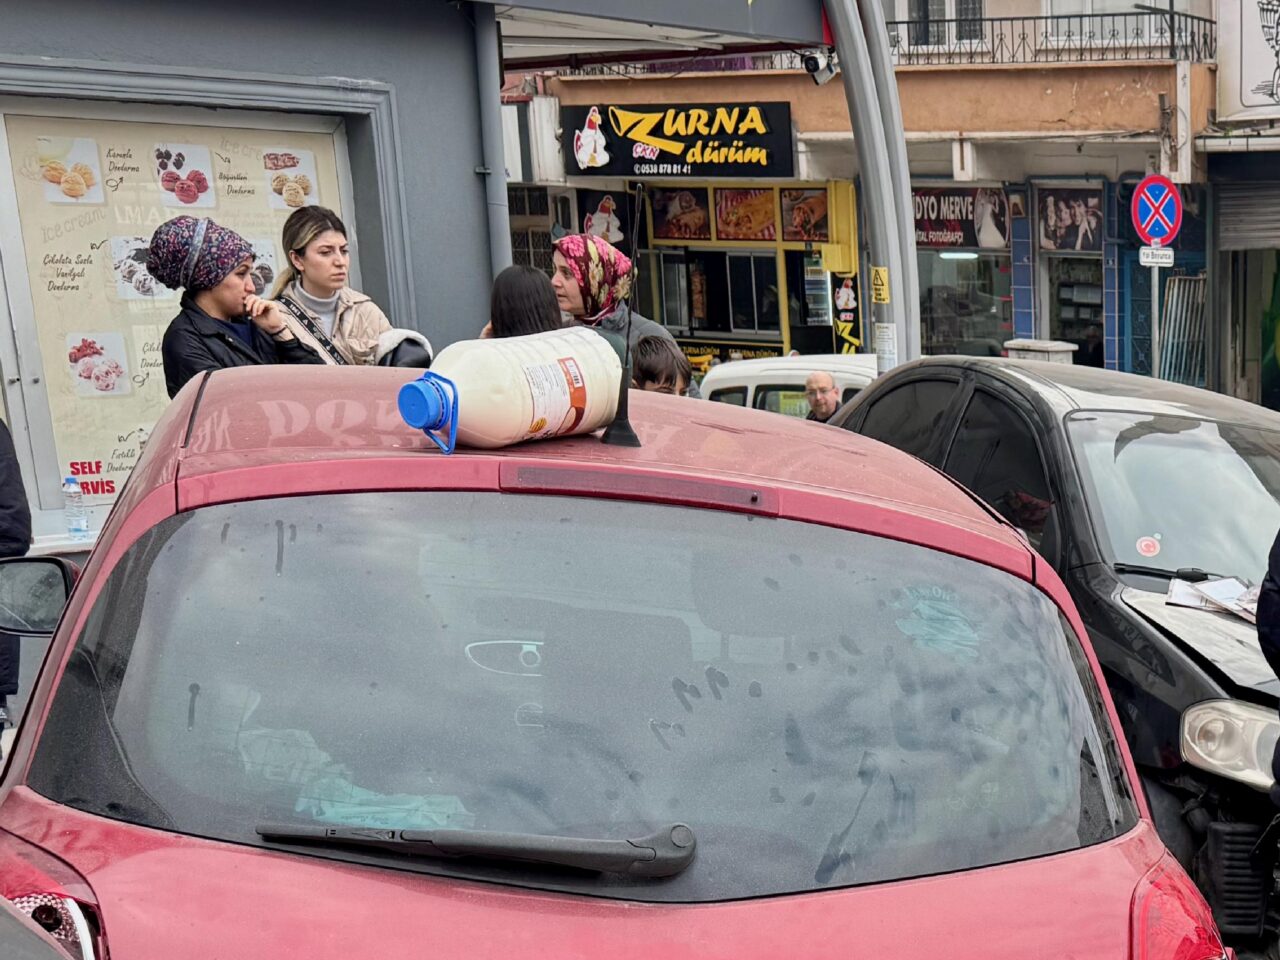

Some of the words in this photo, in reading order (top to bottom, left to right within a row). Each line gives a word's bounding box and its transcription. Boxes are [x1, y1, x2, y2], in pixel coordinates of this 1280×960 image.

[608, 105, 767, 156] ZURNA
[686, 140, 768, 166] dürüm
[641, 163, 658, 174] 0538
[659, 163, 672, 174] 878
[673, 163, 681, 174] 81
[682, 163, 691, 174] 41
[940, 196, 973, 220] MERVE
[70, 461, 103, 476] SELF
